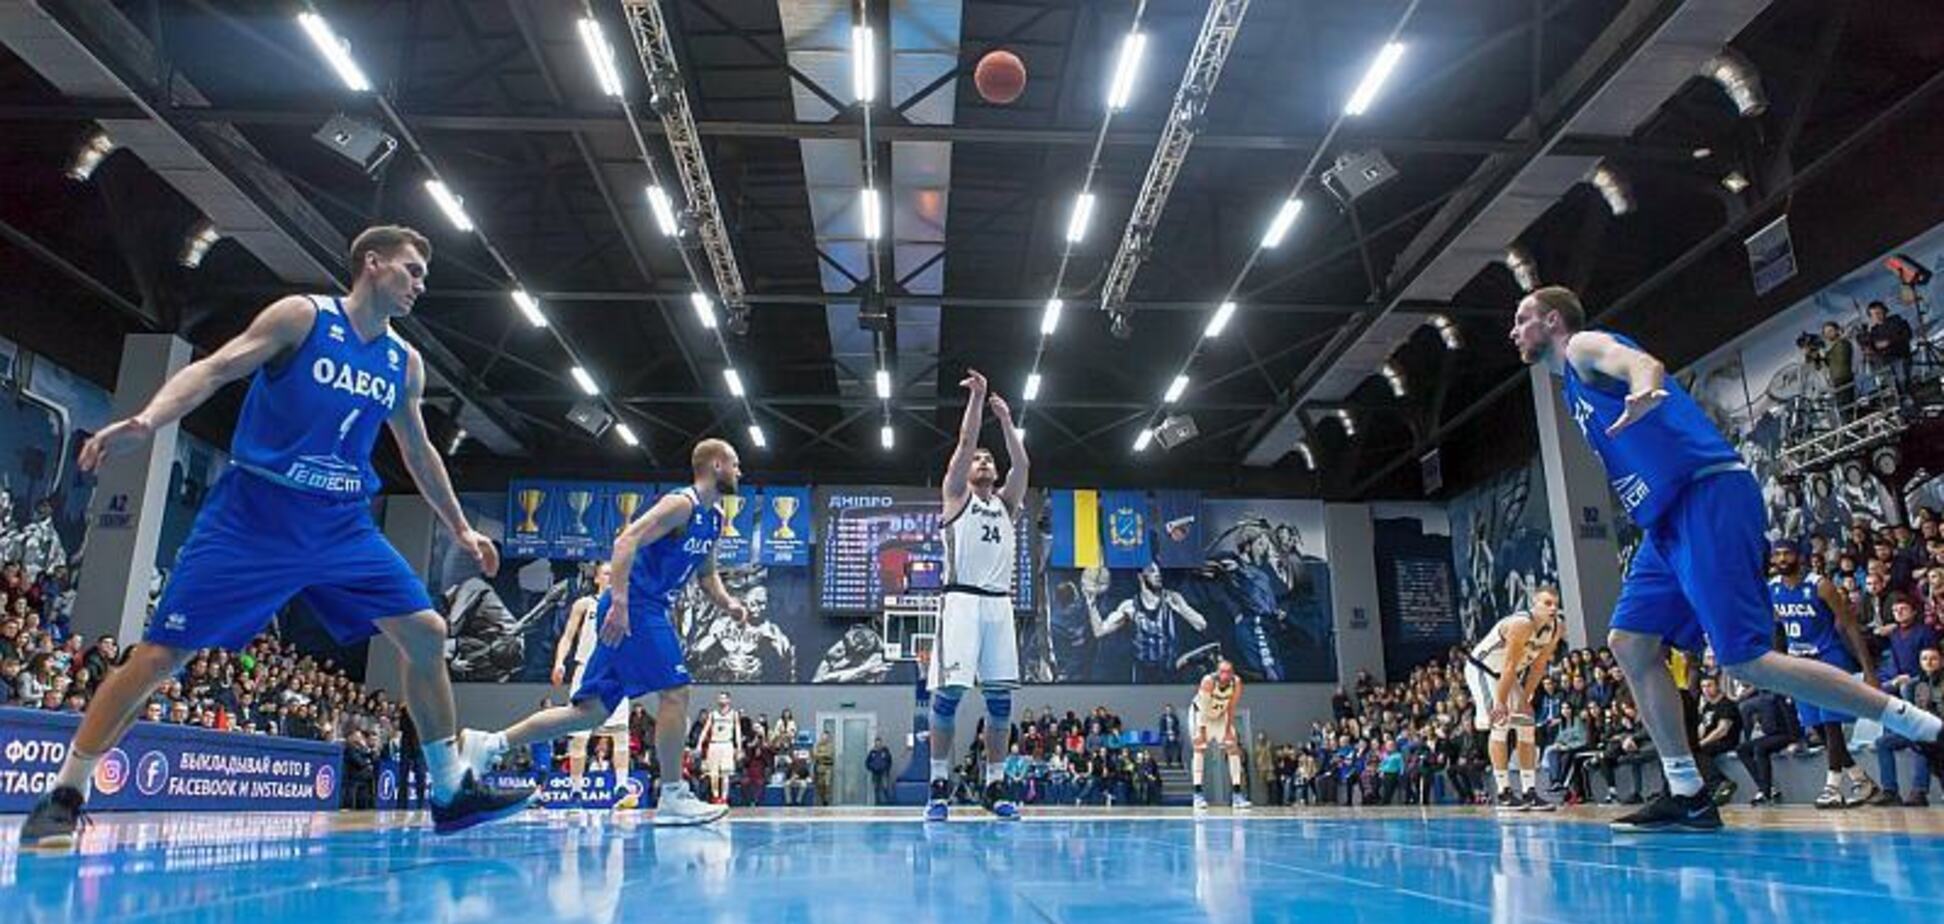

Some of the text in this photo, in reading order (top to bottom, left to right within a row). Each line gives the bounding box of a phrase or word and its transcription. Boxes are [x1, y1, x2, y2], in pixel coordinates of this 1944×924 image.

[313, 357, 396, 410] ОДЕСА
[981, 525, 1001, 544] 24
[5, 740, 65, 763] ФОТО
[180, 752, 311, 778] ВЫКЛАДЫВАЙ ФОТО В
[168, 777, 238, 796] FACEBOOK
[250, 782, 313, 798] INSTAGRAM
[550, 776, 591, 789] ФОО
